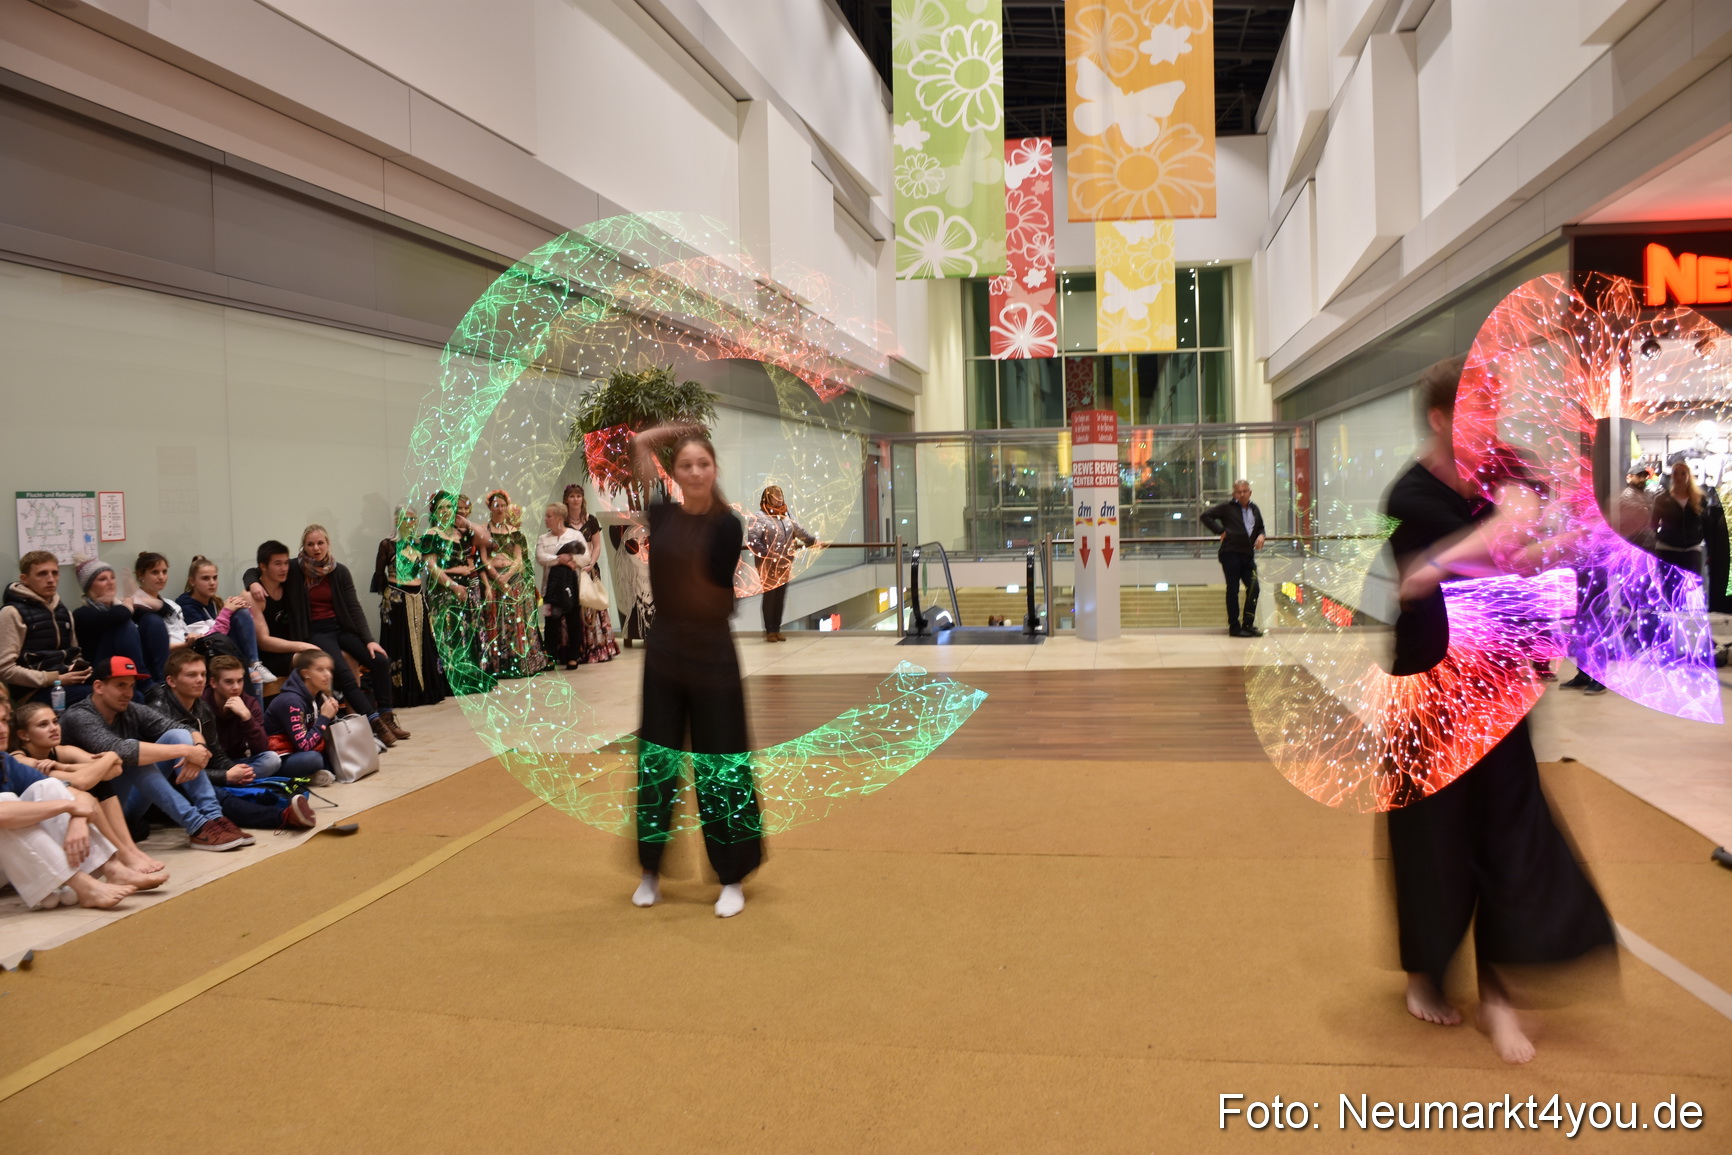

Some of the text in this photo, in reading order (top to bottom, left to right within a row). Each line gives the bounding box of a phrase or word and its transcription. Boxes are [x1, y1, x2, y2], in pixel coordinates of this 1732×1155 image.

[1645, 242, 1732, 306] NE
[1073, 462, 1094, 476] REWE
[1095, 461, 1118, 475] REWE
[1073, 475, 1094, 486] CENTER
[1095, 475, 1118, 486] CENTER
[1078, 501, 1092, 517] dm
[1100, 500, 1115, 517] dm
